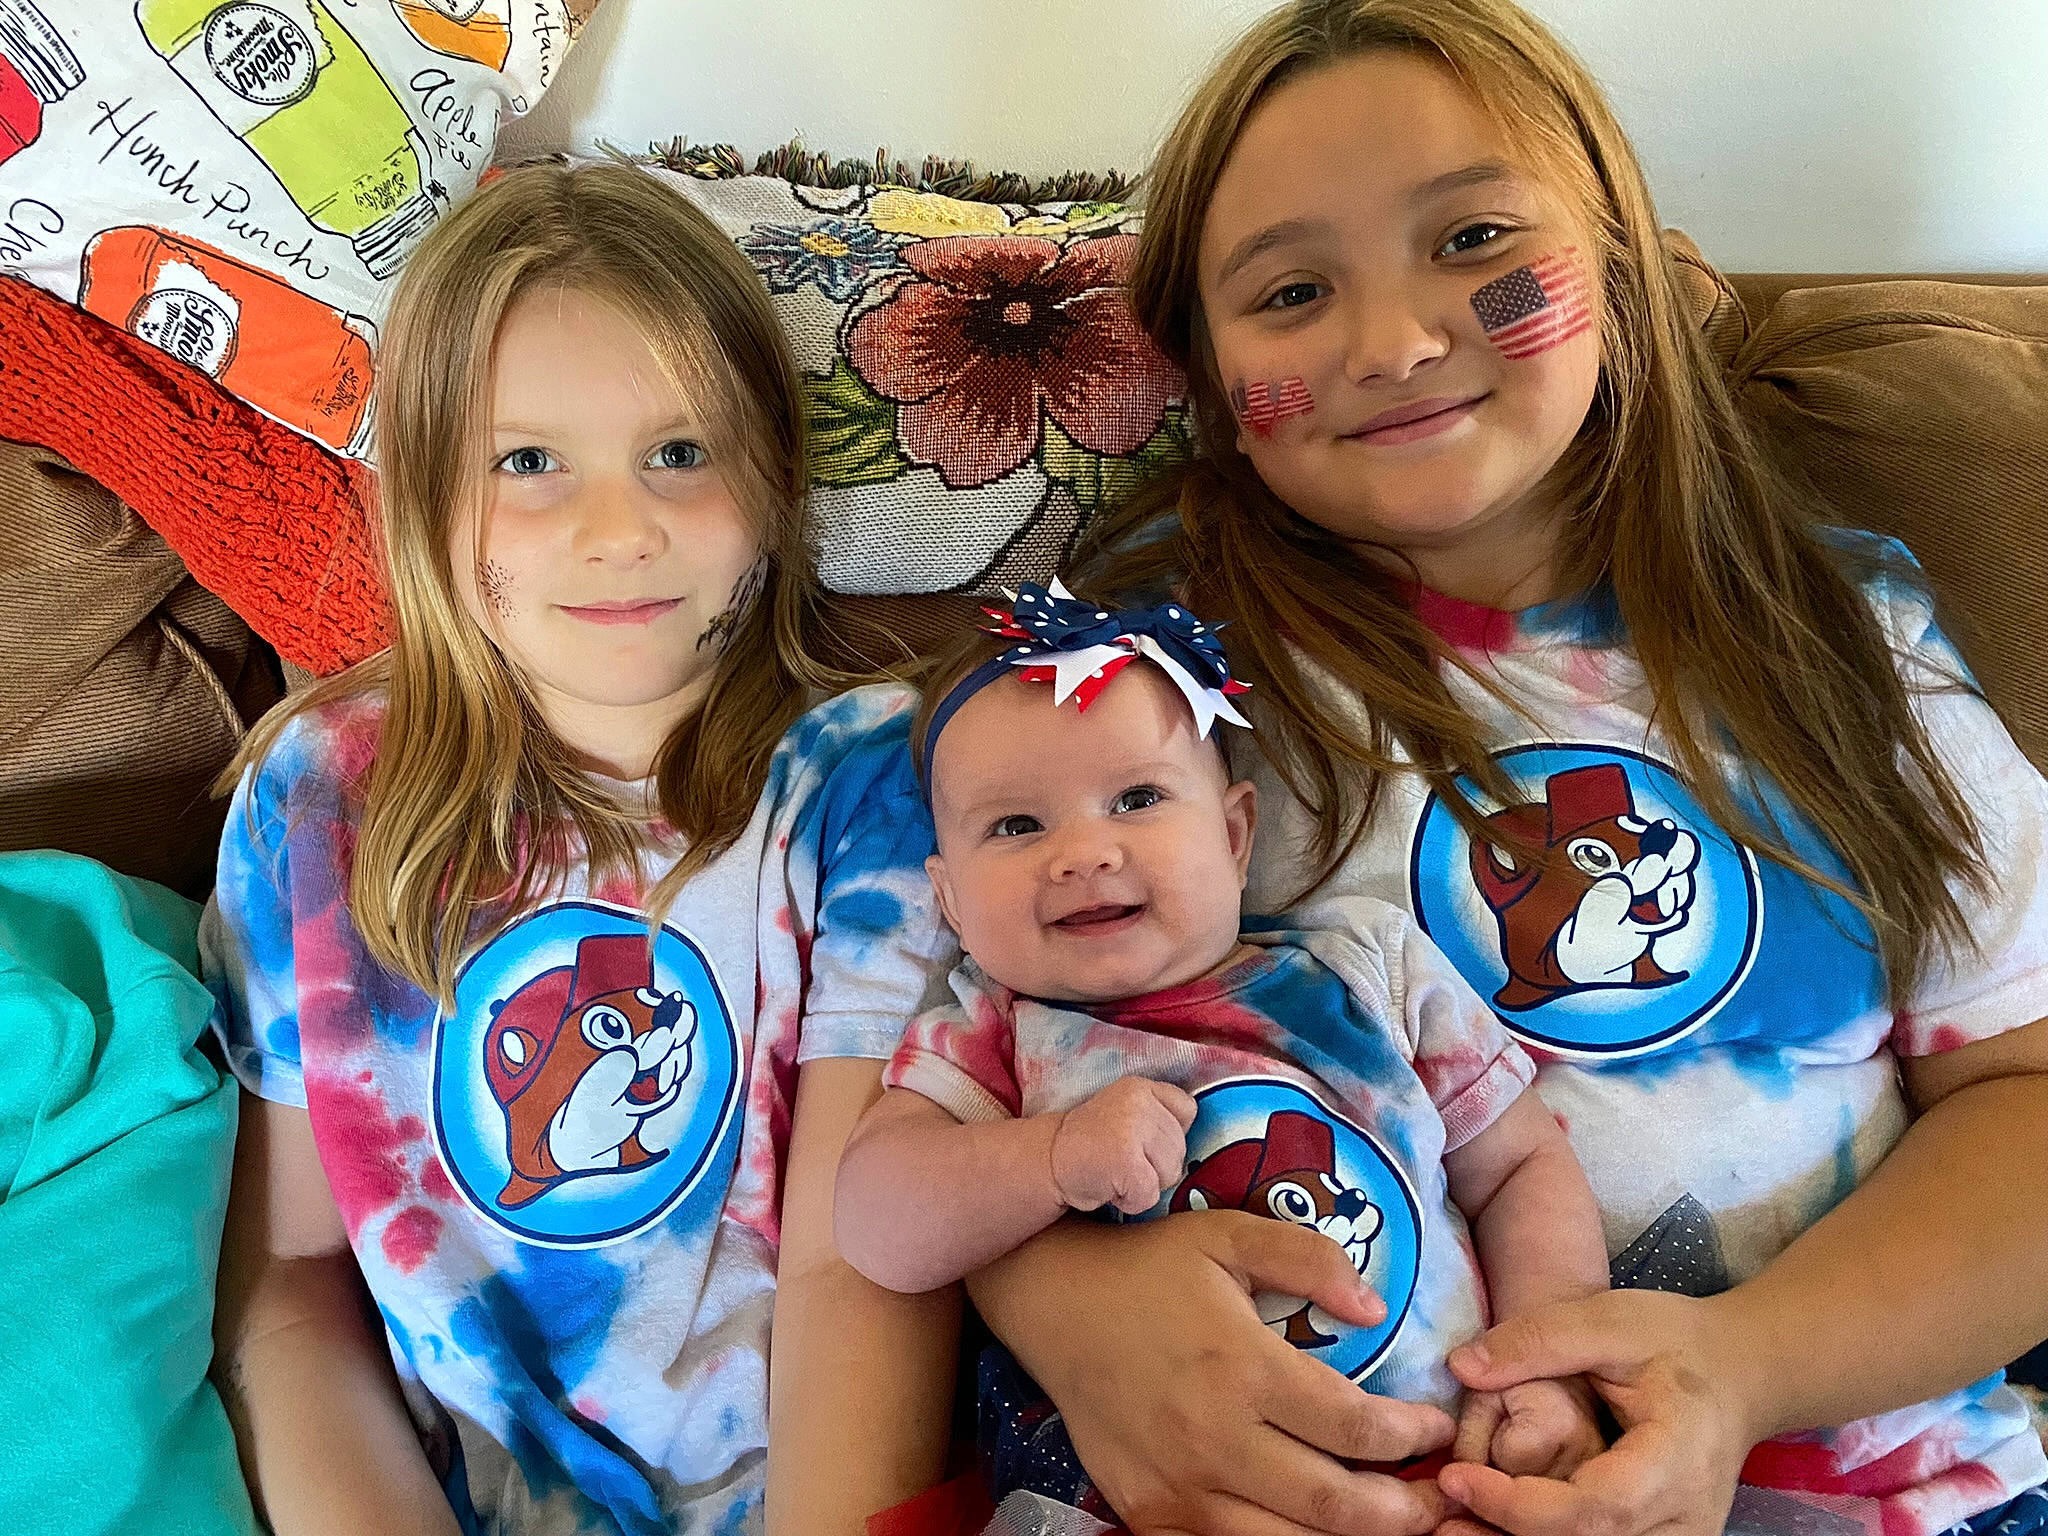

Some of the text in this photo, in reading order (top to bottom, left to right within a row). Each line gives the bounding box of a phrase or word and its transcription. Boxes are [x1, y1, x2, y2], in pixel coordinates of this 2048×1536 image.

[217, 17, 275, 68] Moonshine
[234, 26, 303, 96] Smoky
[264, 60, 291, 85] Ole
[532, 2, 560, 88] ntain
[90, 97, 328, 280] Hunch Punch
[194, 337, 214, 364] Ole
